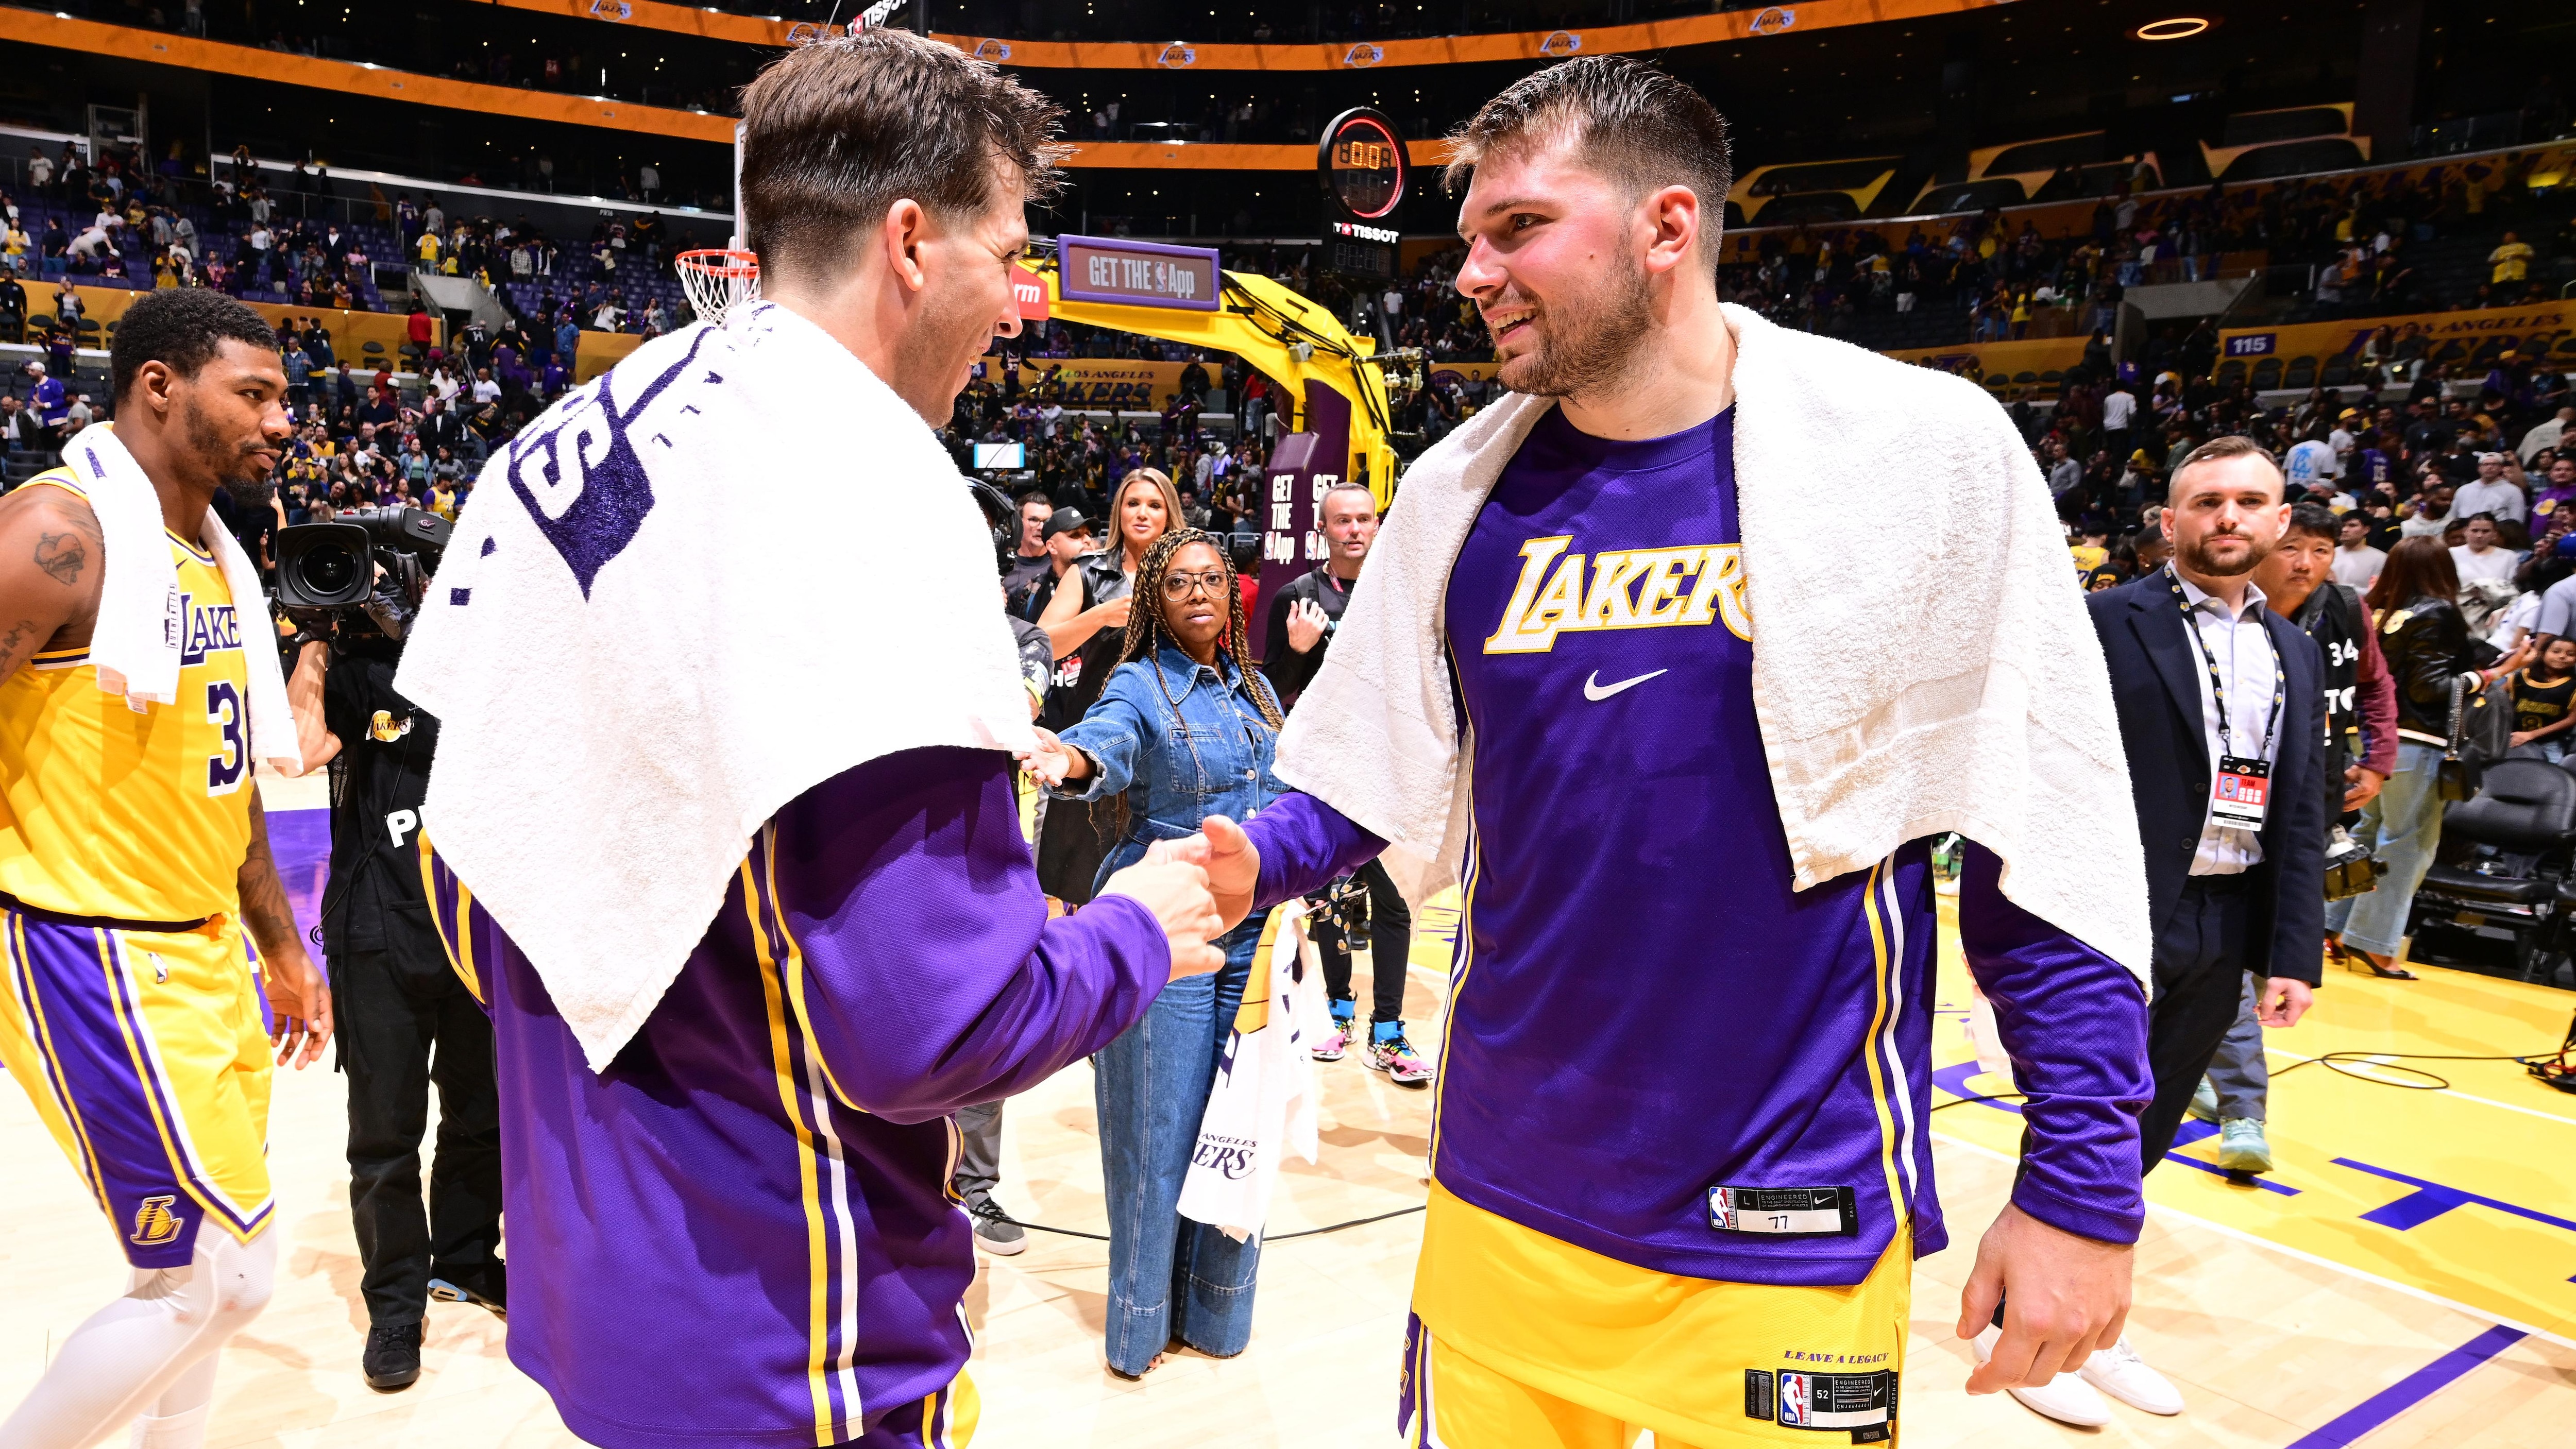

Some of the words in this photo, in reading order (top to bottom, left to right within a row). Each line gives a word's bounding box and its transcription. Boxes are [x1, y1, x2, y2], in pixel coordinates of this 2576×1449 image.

[1351, 224, 1399, 244] TISSOT
[1089, 255, 1118, 287] GET
[1122, 259, 1152, 290] THE
[1168, 263, 1195, 298] App
[2440, 314, 2564, 334] ANGELES
[2233, 336, 2266, 354] 115
[1092, 370, 1155, 379] ANGELES
[1272, 474, 1294, 502] GET
[1271, 502, 1293, 530] THE
[1273, 531, 1295, 565] App
[1483, 534, 1754, 655] LAKER
[2328, 638, 2359, 667] 34
[369, 720, 408, 738] LAKERS
[1201, 1133, 1258, 1147] ANGELES
[1192, 1140, 1257, 1180] ERS
[1744, 1196, 1750, 1205] L
[1768, 1215, 1788, 1229] 77
[1784, 1350, 1833, 1363] LEAVE
[1836, 1355, 1845, 1363] A
[1849, 1353, 1889, 1364] LEGACY
[1817, 1390, 1828, 1400] 52
[1784, 1412, 1796, 1422] NBA
